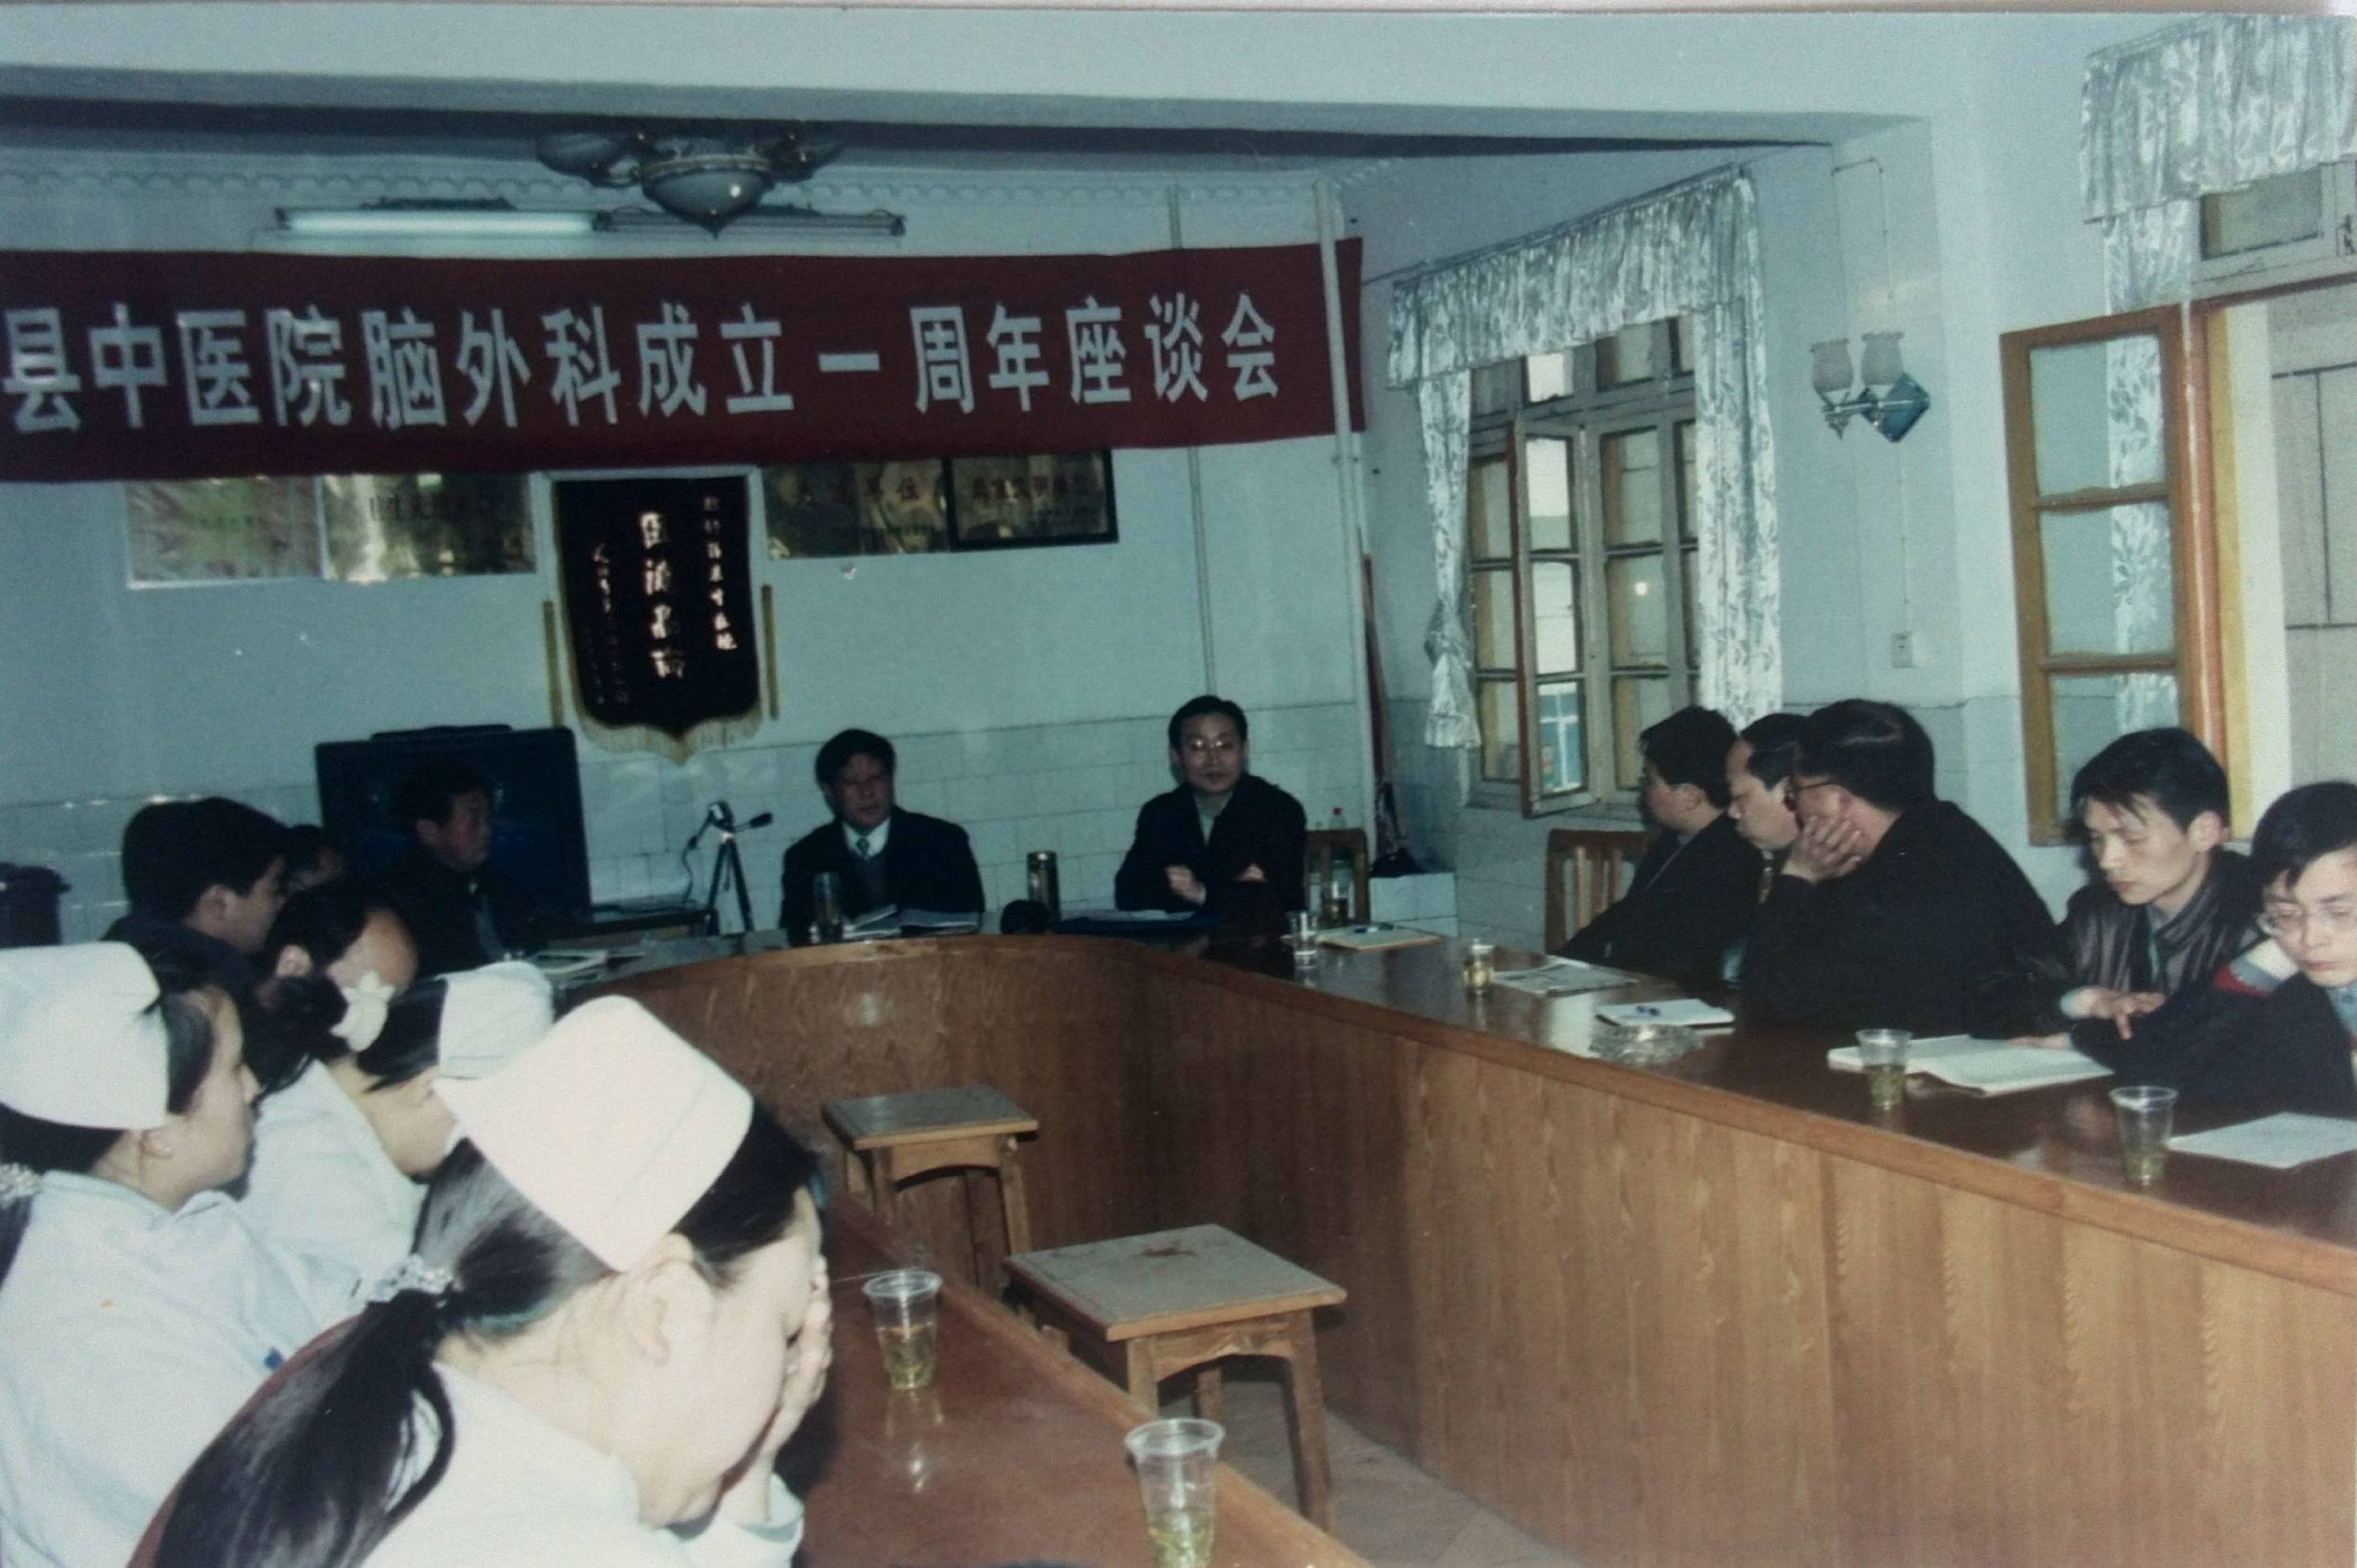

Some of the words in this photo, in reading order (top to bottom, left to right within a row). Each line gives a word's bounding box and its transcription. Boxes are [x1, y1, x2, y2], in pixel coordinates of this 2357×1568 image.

[3, 293, 1280, 434] 县中医院脑外科成立一周年座谈会
